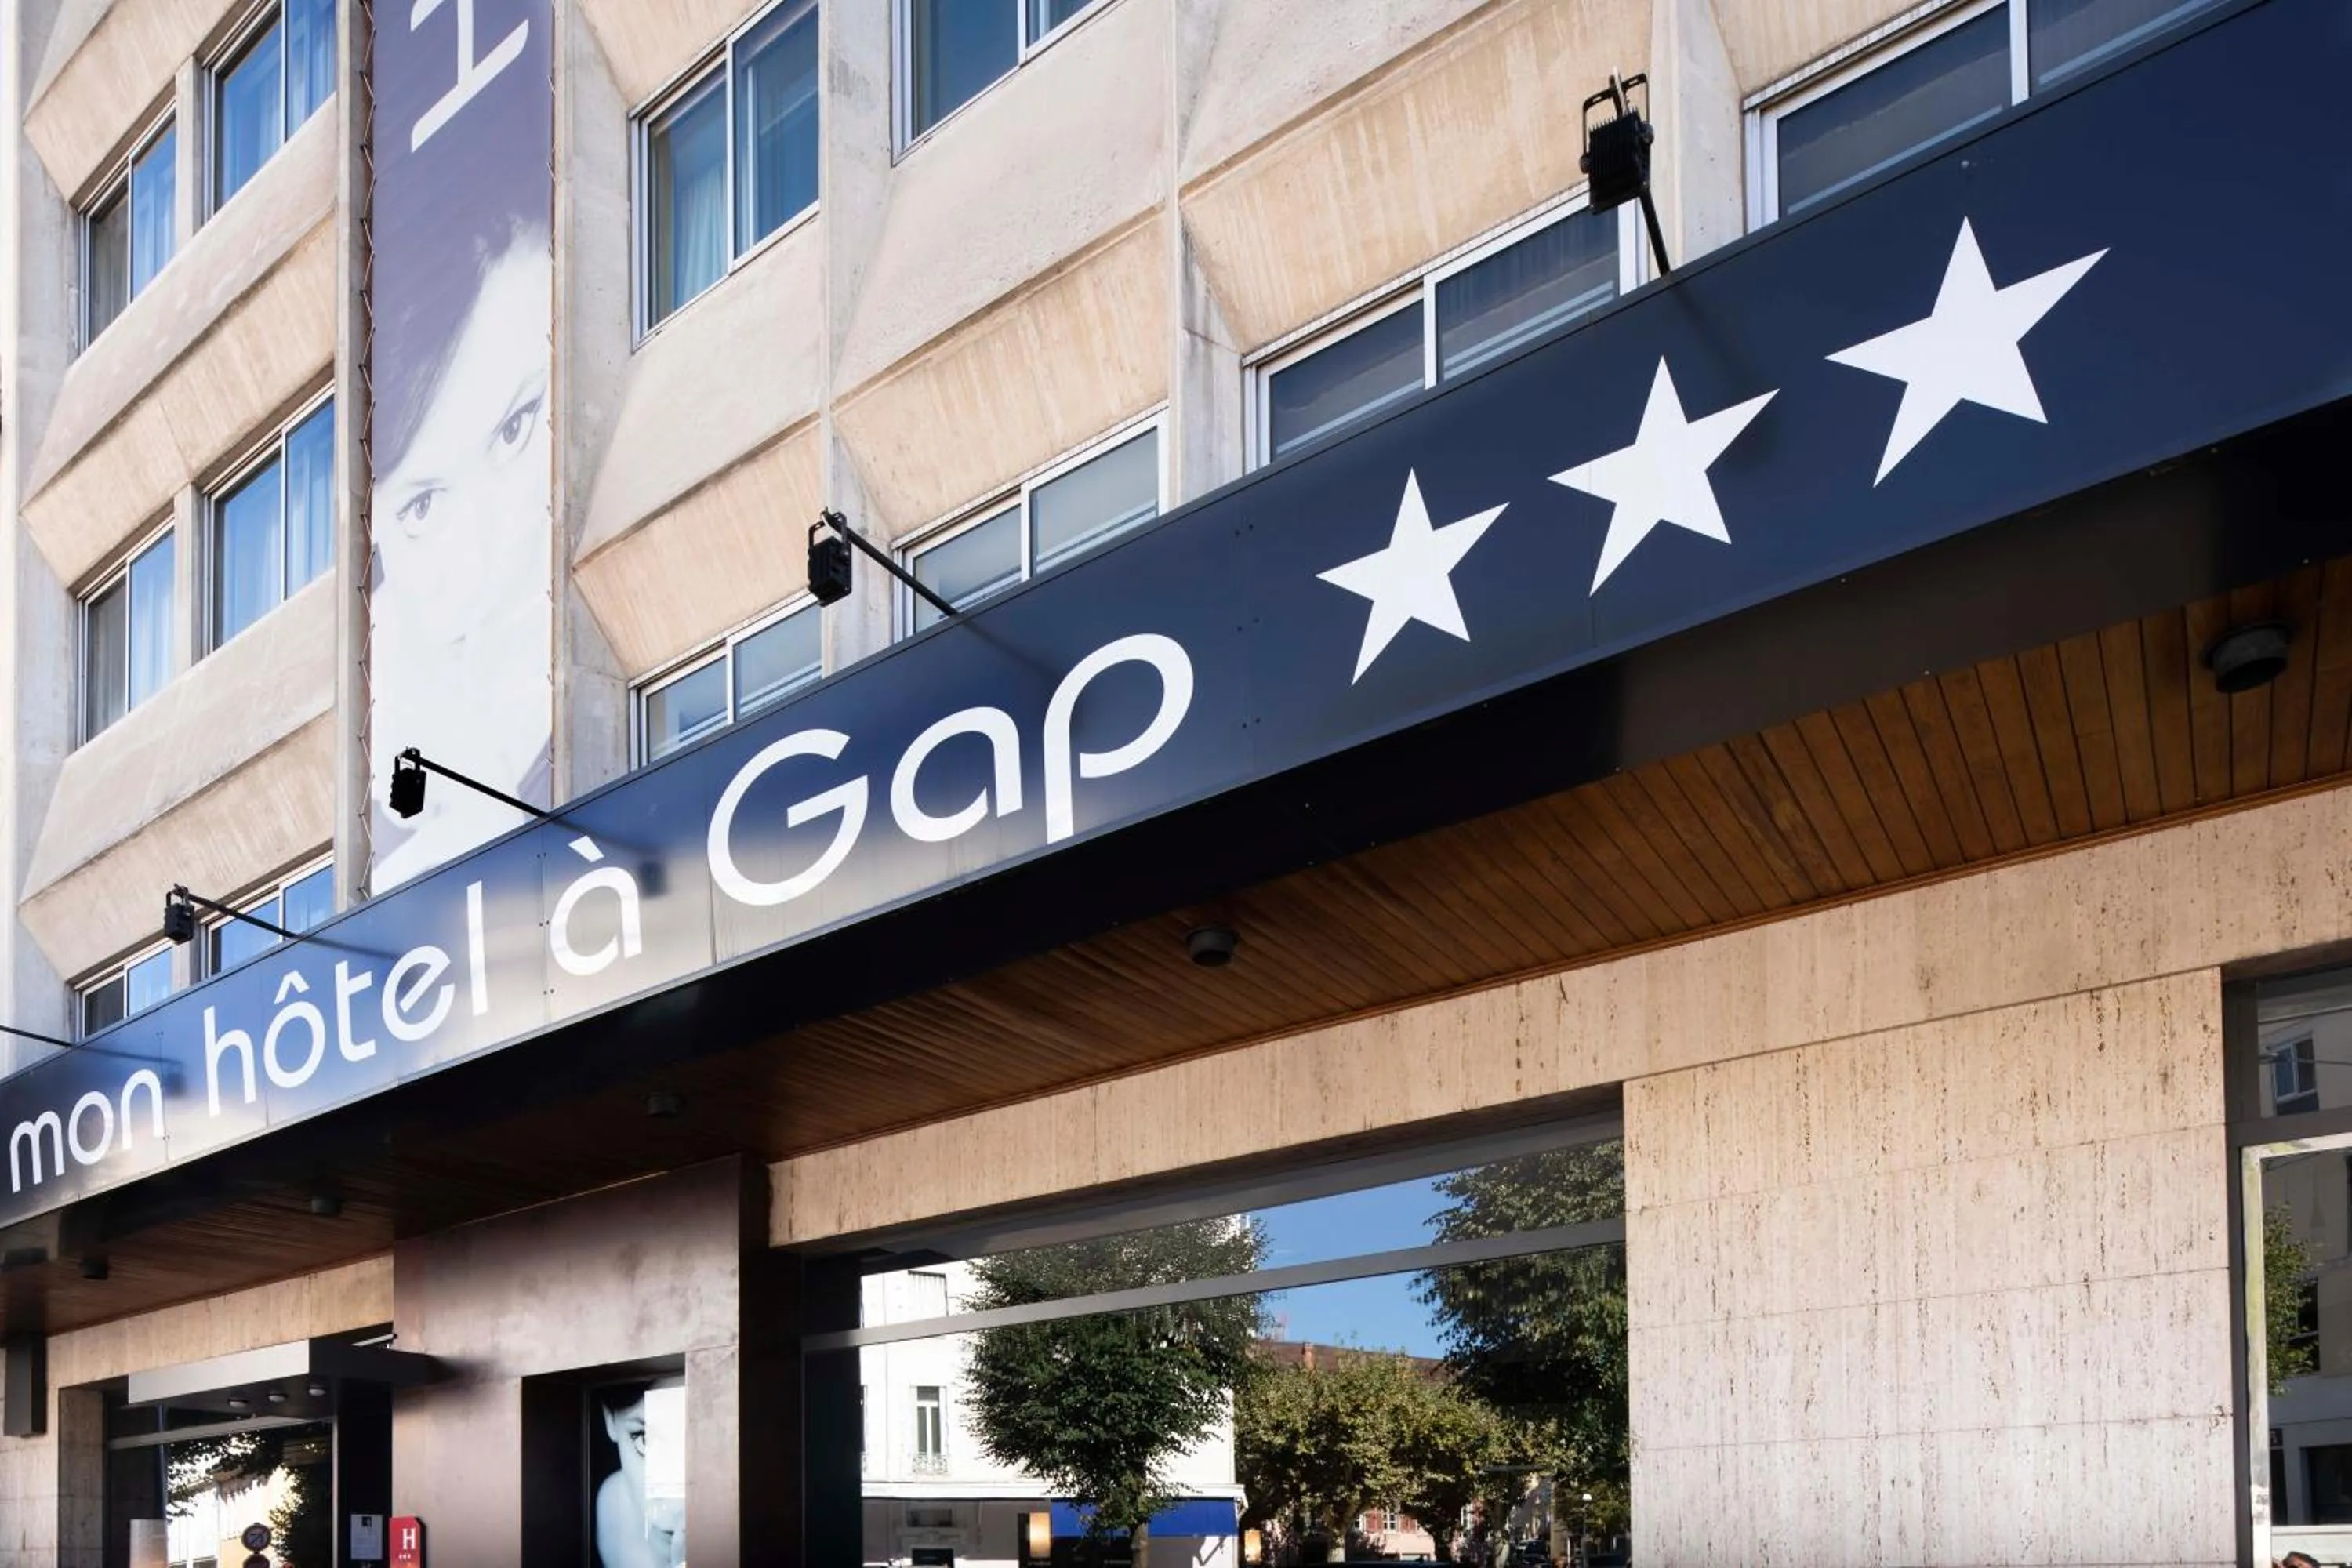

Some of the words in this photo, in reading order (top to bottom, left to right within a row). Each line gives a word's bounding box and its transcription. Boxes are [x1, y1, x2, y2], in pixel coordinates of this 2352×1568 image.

[9, 1069, 164, 1192] mon
[203, 880, 489, 1119] hôtel
[549, 835, 643, 977] à
[707, 633, 1194, 906] Gap
[401, 1528, 416, 1550] H
